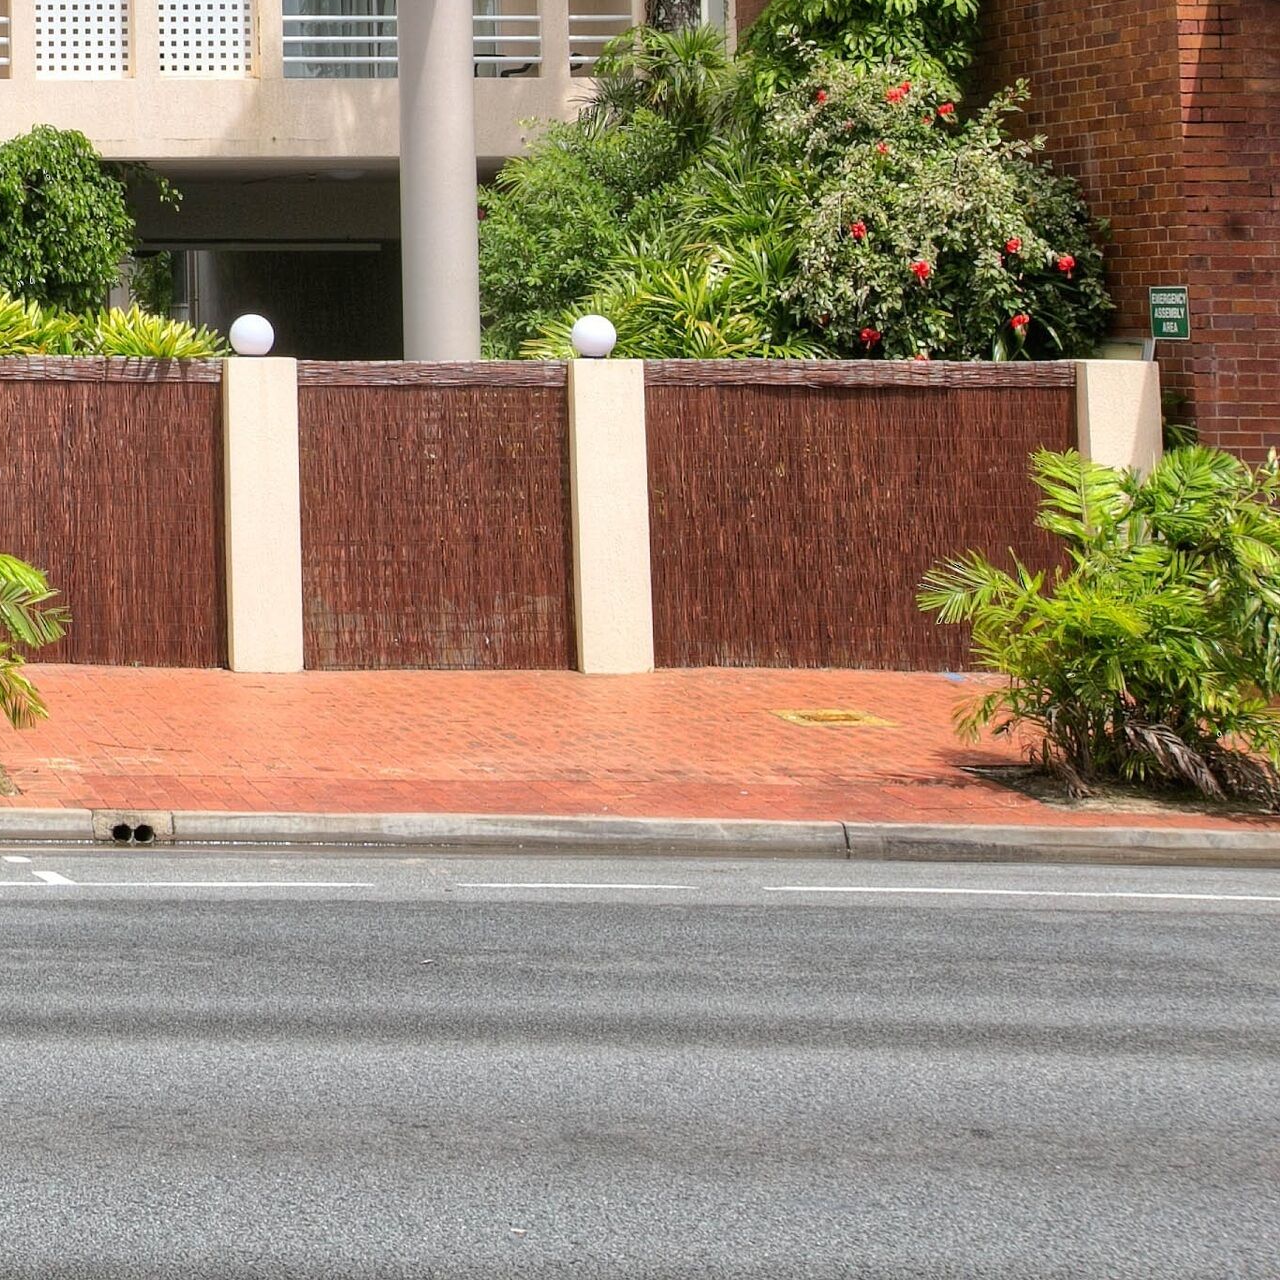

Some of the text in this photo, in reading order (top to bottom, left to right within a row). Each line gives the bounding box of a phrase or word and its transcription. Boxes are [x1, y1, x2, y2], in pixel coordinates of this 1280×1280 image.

[1151, 293, 1186, 305] EMERGENCY
[1154, 307, 1185, 319] ASSEMBLY
[1162, 322, 1178, 333] AREA
